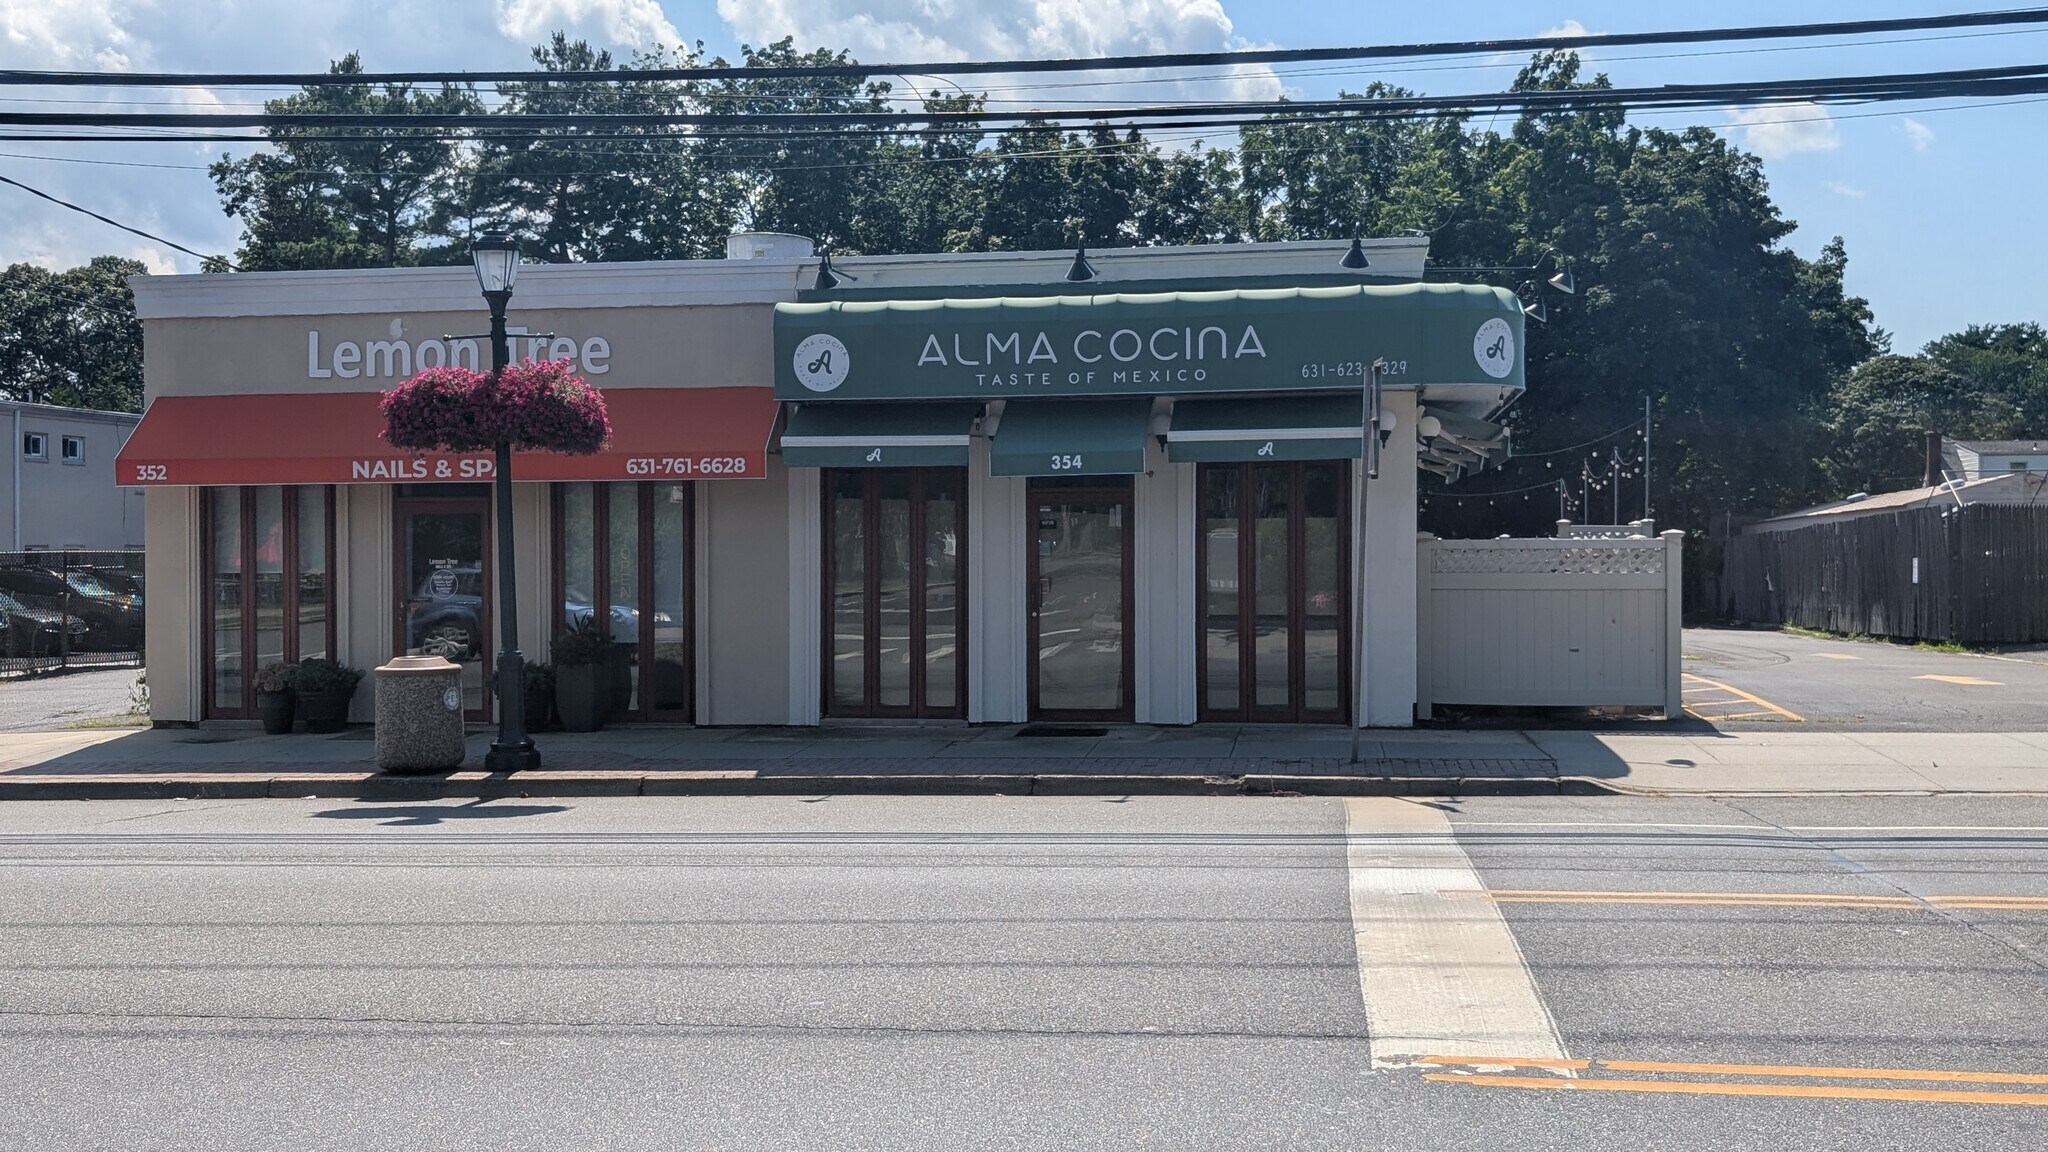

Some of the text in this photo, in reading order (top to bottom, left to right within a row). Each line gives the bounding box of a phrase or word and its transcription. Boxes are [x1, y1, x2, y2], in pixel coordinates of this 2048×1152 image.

[308, 326, 611, 378] Lemon Tree
[917, 325, 1267, 366] ALMA COCINA
[807, 349, 833, 375] A
[1301, 360, 1407, 378] 631-623329
[976, 369, 1207, 386] TASTE OF MEXICO
[136, 465, 168, 481] 352
[352, 457, 747, 479] NAILS & SP 631-761-6628
[1050, 454, 1083, 470] 354
[620, 547, 632, 599] OPEN
